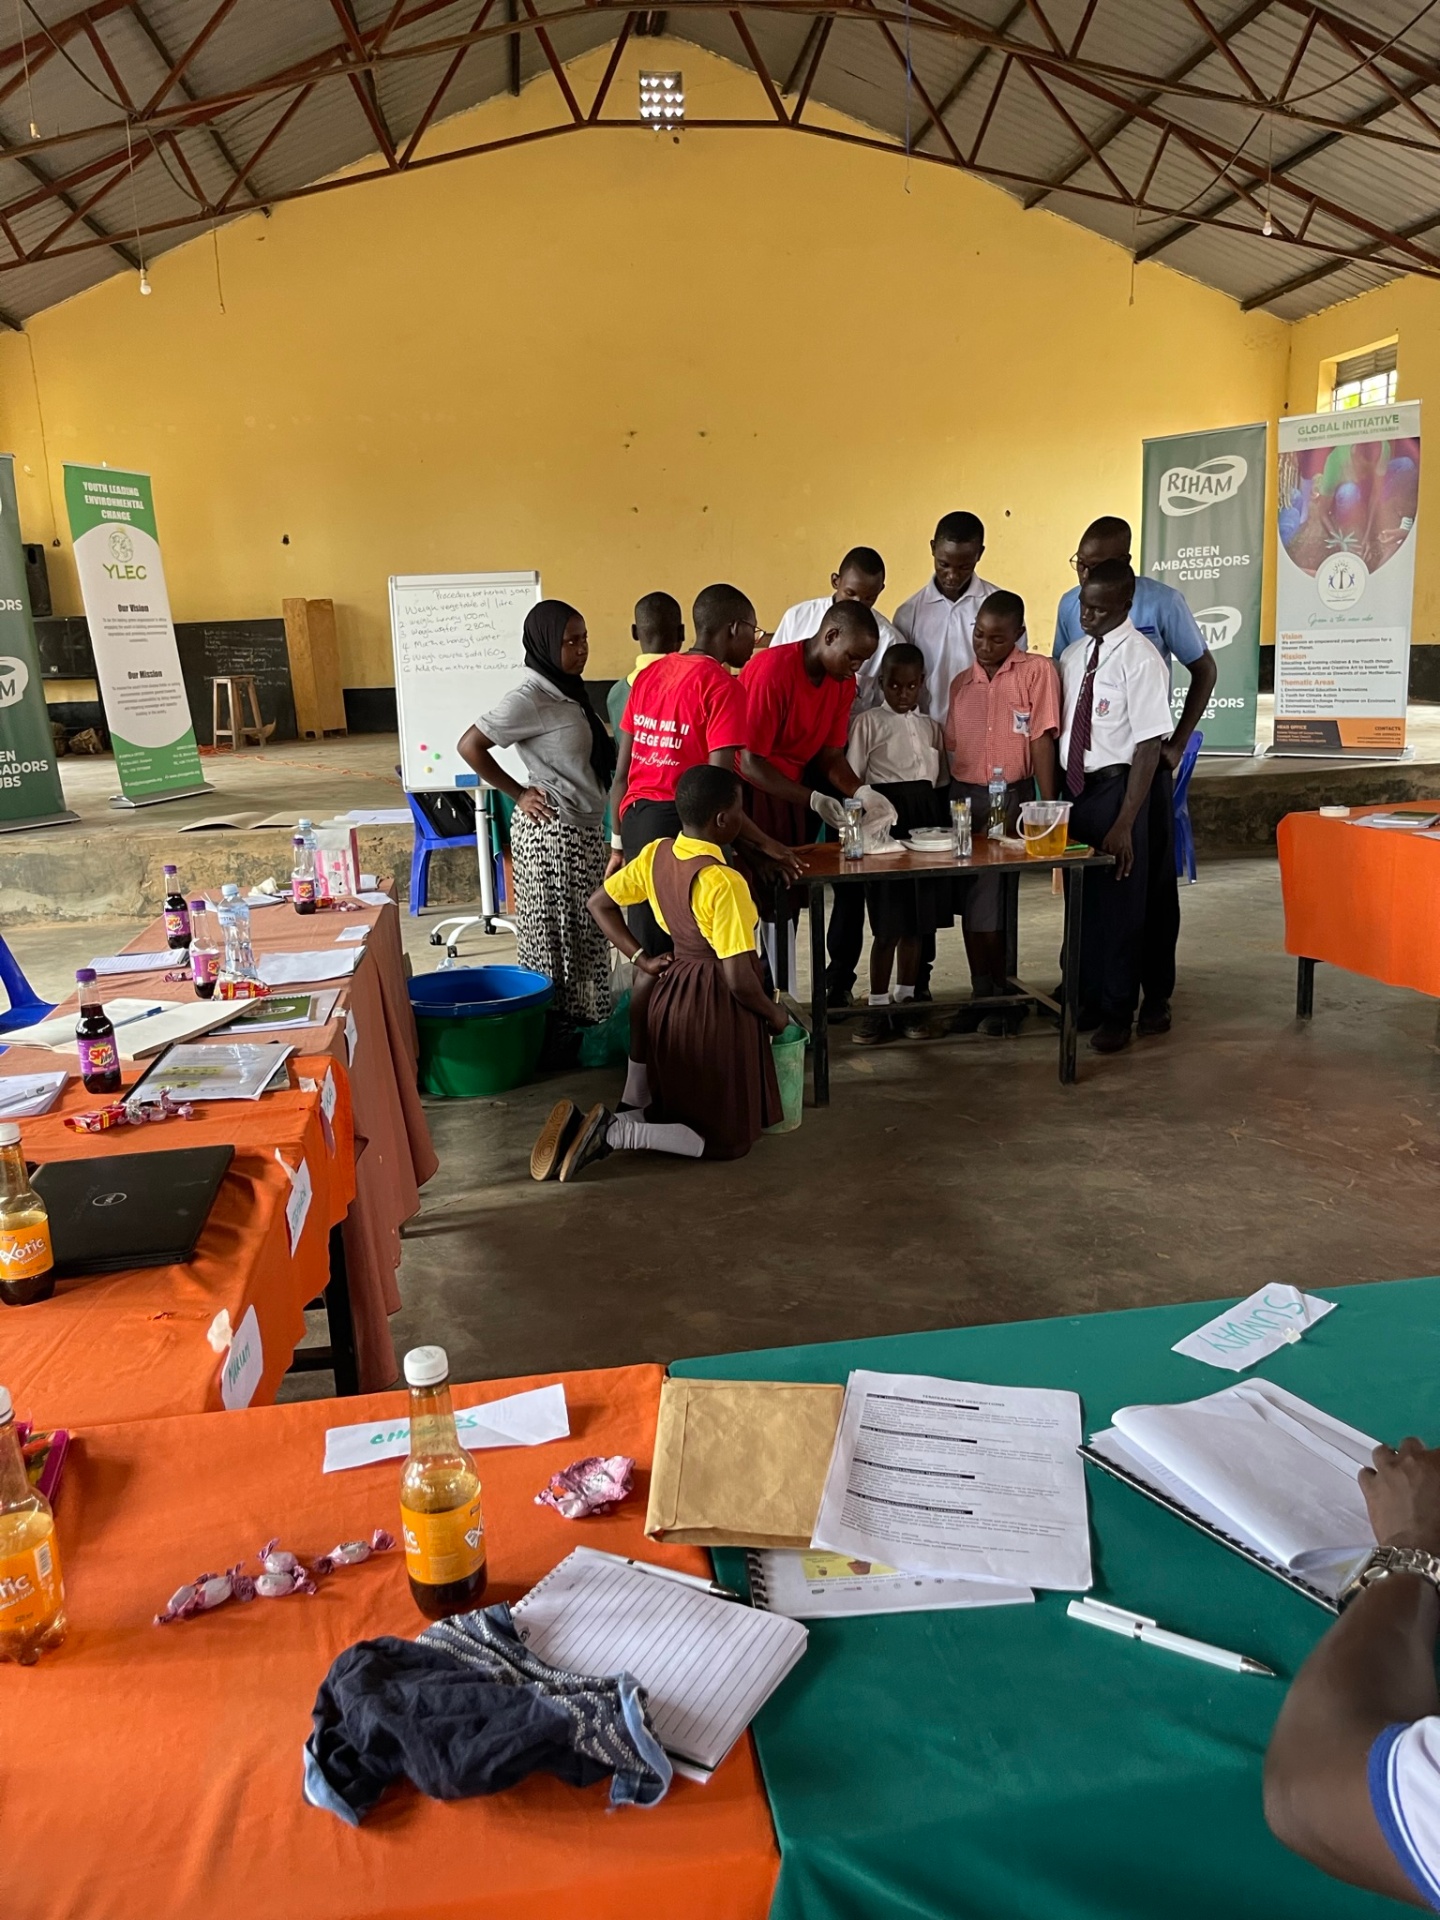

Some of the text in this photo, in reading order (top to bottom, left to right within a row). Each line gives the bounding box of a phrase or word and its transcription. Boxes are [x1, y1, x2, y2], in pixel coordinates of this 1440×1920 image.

[1298, 414, 1400, 435] GLOBAL INITIATIVE
[82, 481, 140, 497] YOUTH LEADING
[1167, 472, 1233, 496] RIHAM
[84, 494, 145, 510] ENVIRONMENTAL
[101, 509, 132, 521] CHANGE
[1177, 545, 1220, 558] GREEN
[1151, 554, 1251, 572] AMBASSADORS
[103, 563, 147, 580] YLEC
[1178, 568, 1220, 581] CLUBS
[129, 604, 150, 612] Vision
[139, 670, 163, 679] Mission
[1196, 1295, 1304, 1354] SUNDAY
